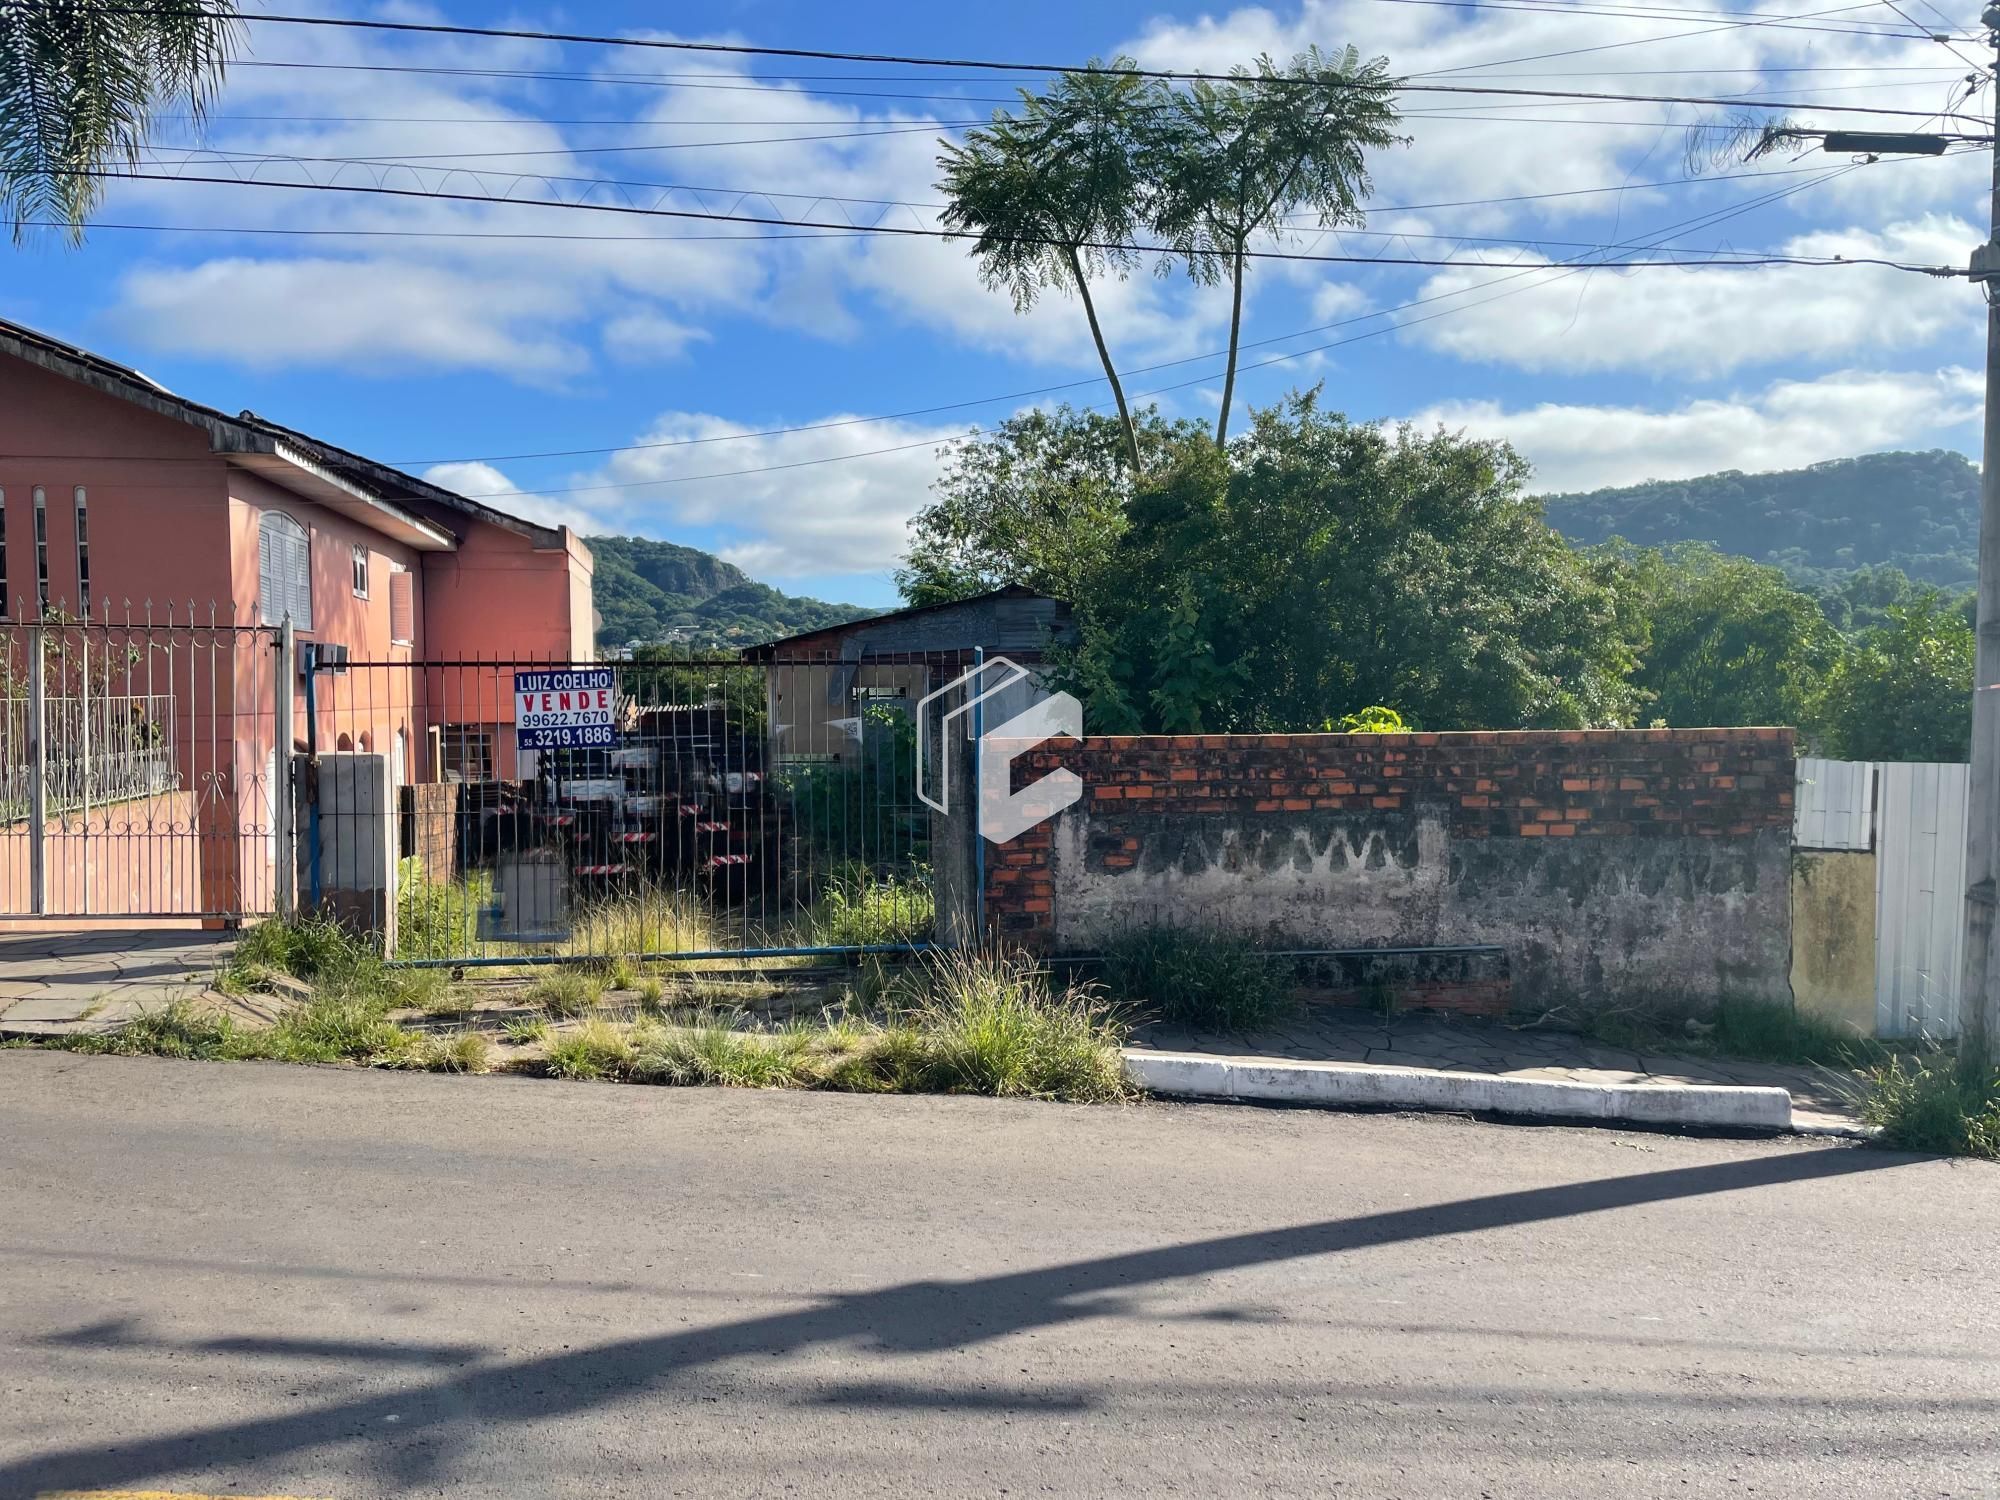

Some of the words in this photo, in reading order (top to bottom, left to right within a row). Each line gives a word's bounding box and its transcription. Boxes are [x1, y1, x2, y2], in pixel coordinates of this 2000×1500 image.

[520, 675, 551, 691] LUIZ
[553, 672, 608, 689] COELHO
[523, 690, 608, 712] VENDE
[522, 710, 609, 727] 99622.7670
[524, 738, 533, 746] 55
[535, 726, 611, 746] 3219.1886
